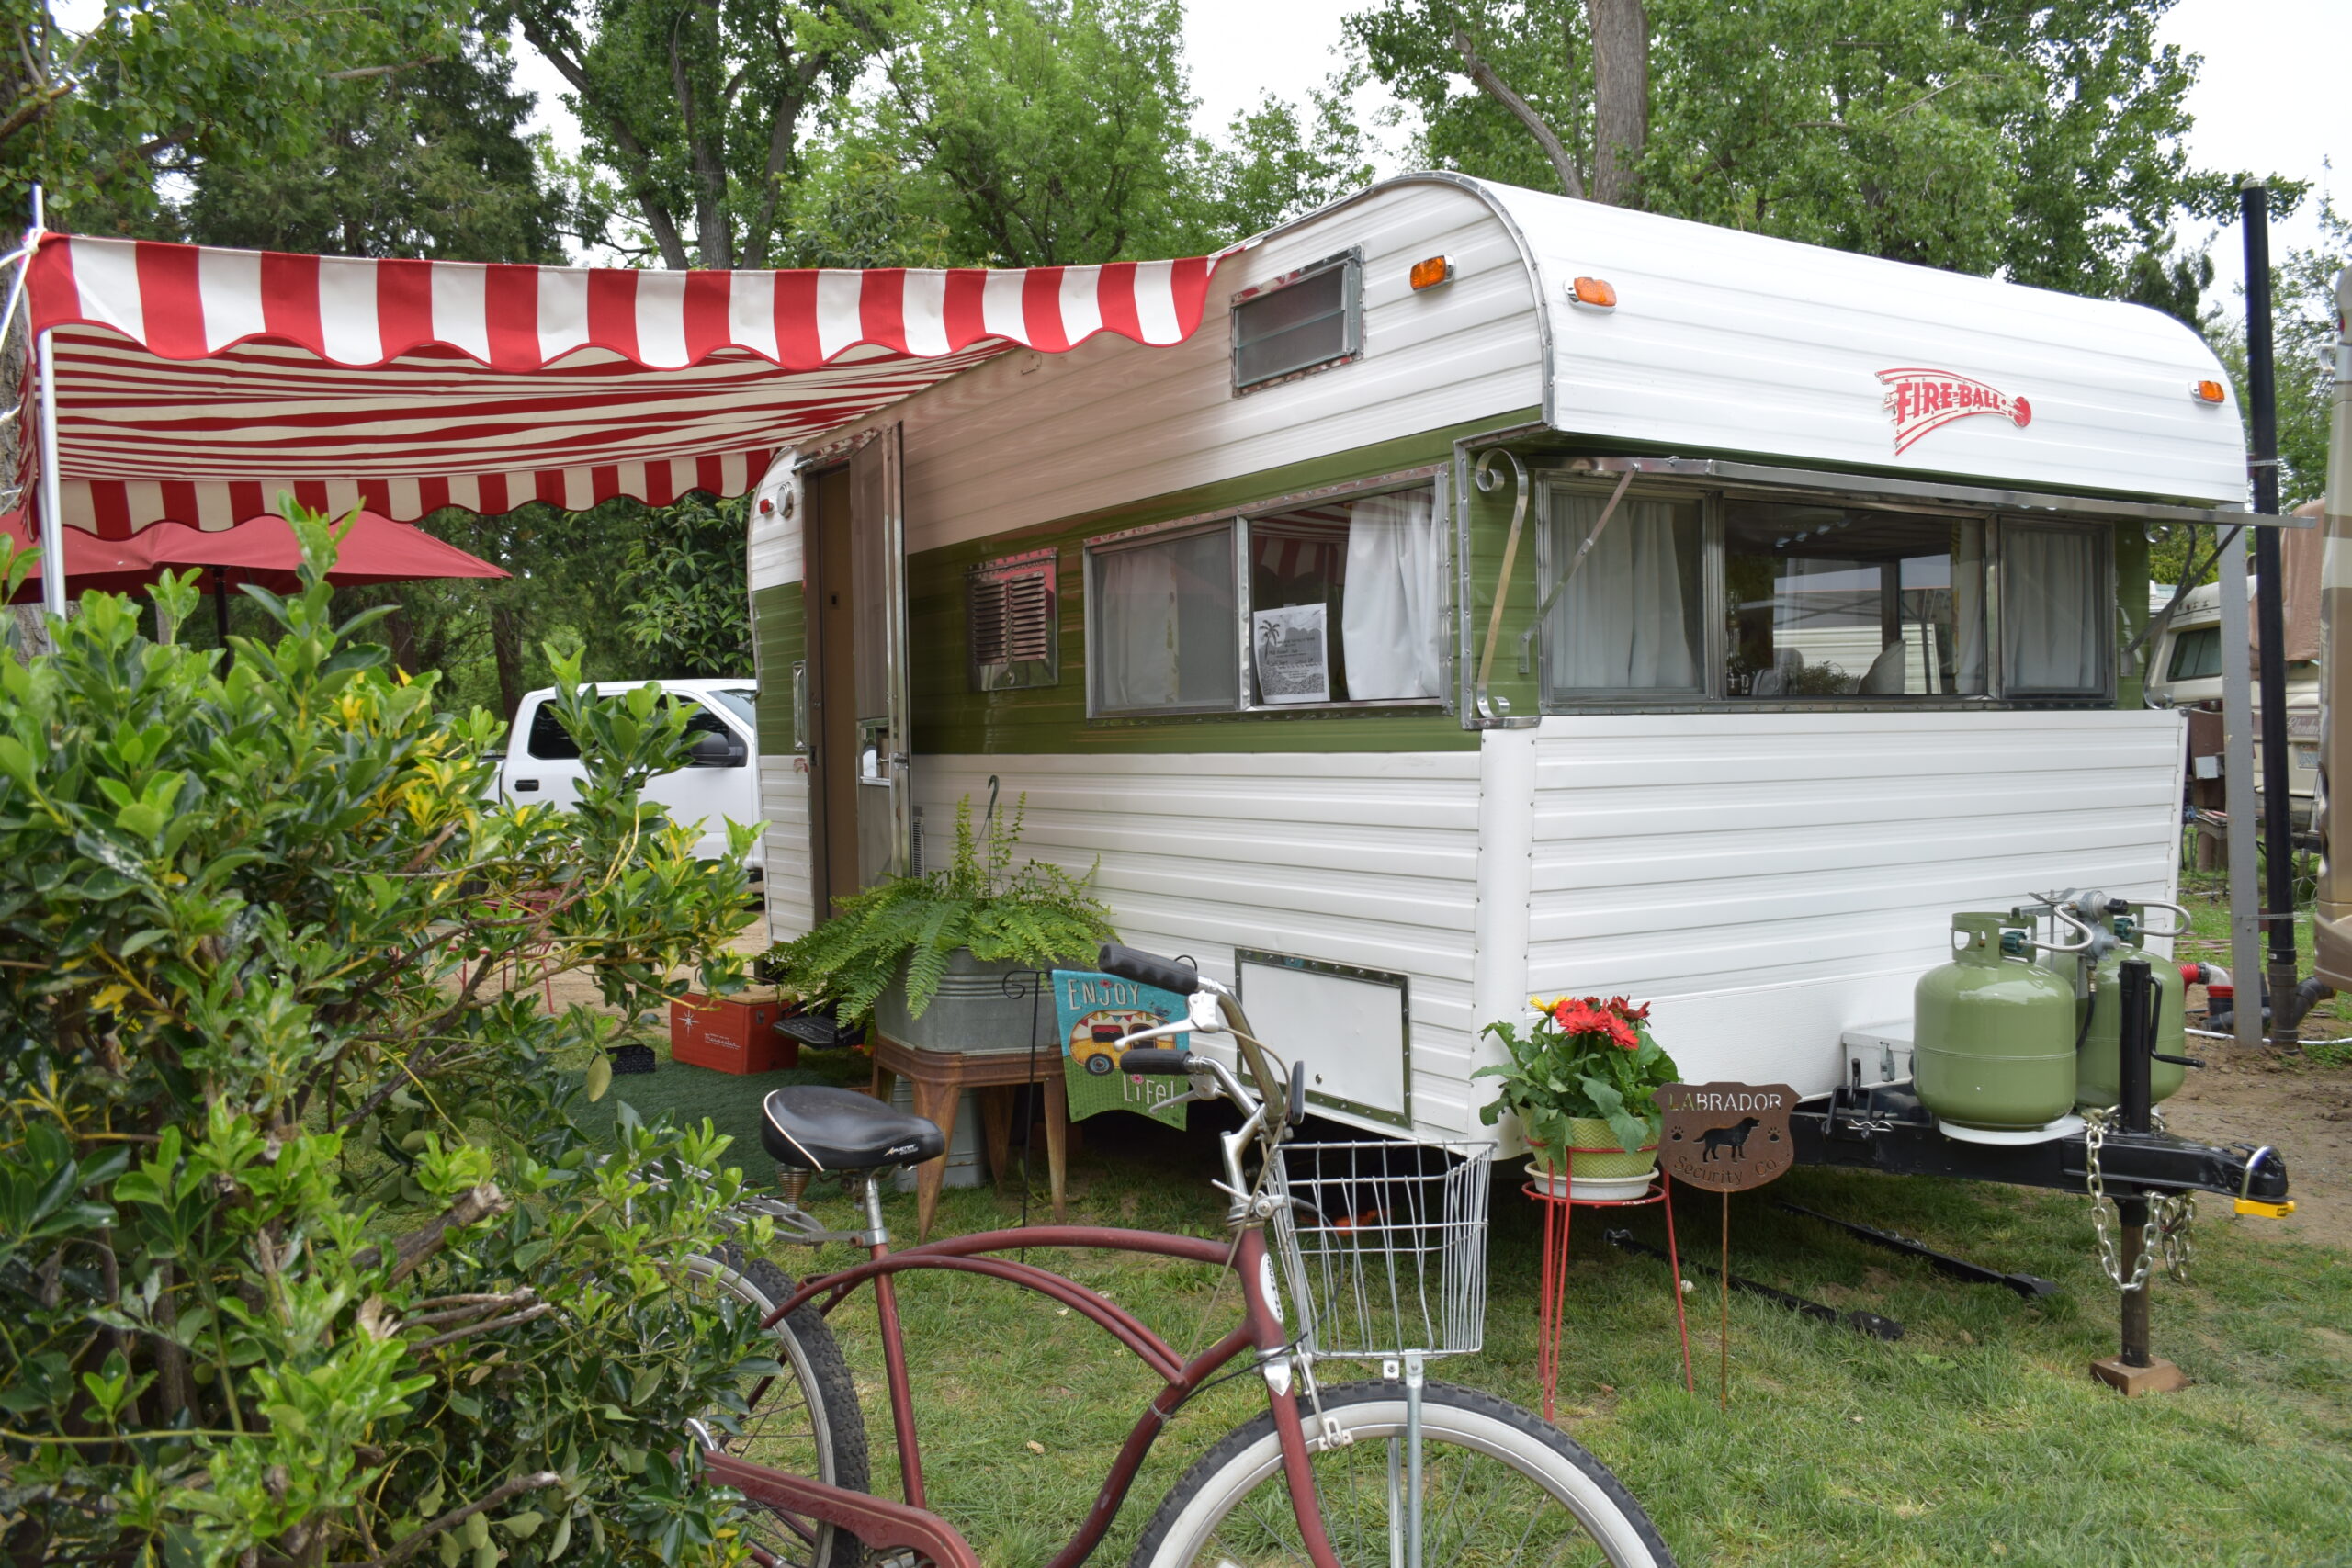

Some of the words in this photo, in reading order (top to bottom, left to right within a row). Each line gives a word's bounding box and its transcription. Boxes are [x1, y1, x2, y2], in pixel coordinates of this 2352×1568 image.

[1068, 979, 1139, 1010] ENJOY
[1668, 1093, 1781, 1111] LABRADOR
[1674, 1156, 1742, 1185] Security
